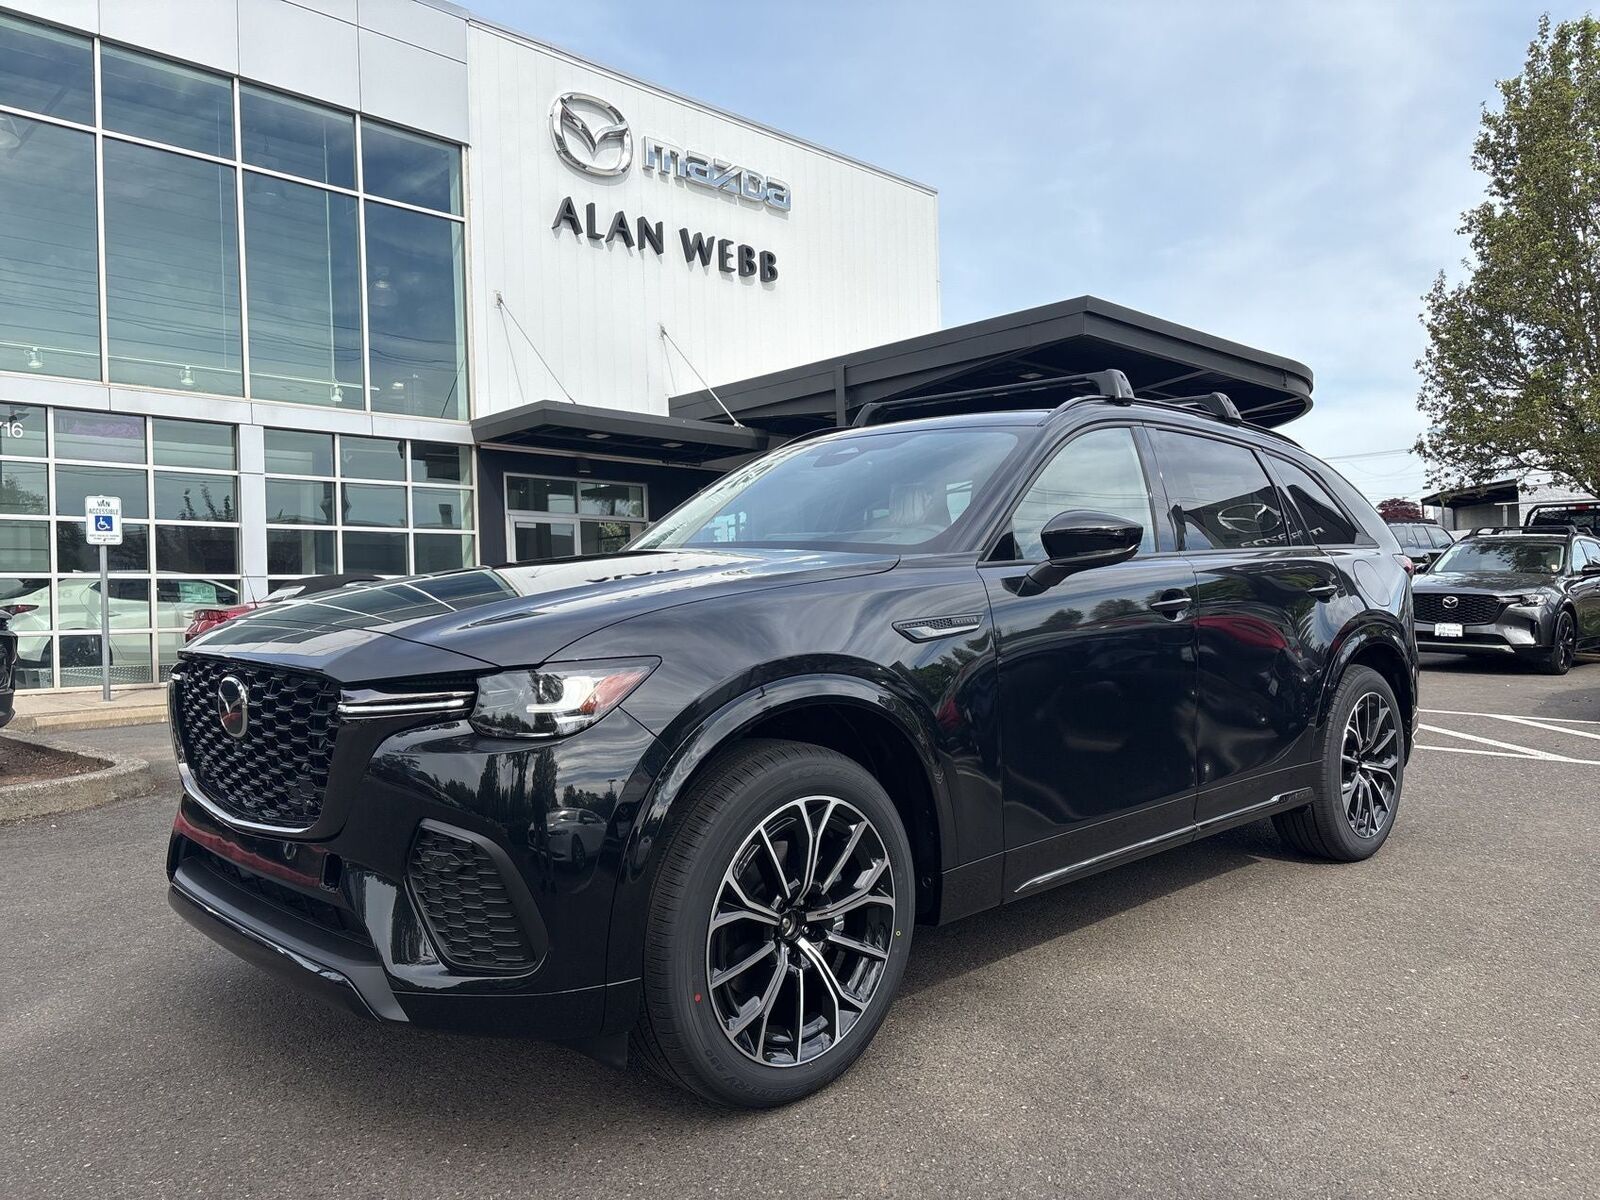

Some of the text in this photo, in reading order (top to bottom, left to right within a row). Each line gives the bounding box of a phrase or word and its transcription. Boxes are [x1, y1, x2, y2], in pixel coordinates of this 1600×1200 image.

[642, 136, 791, 212] mazda
[551, 196, 778, 282] ALAN WEBB
[0, 422, 24, 438] 16
